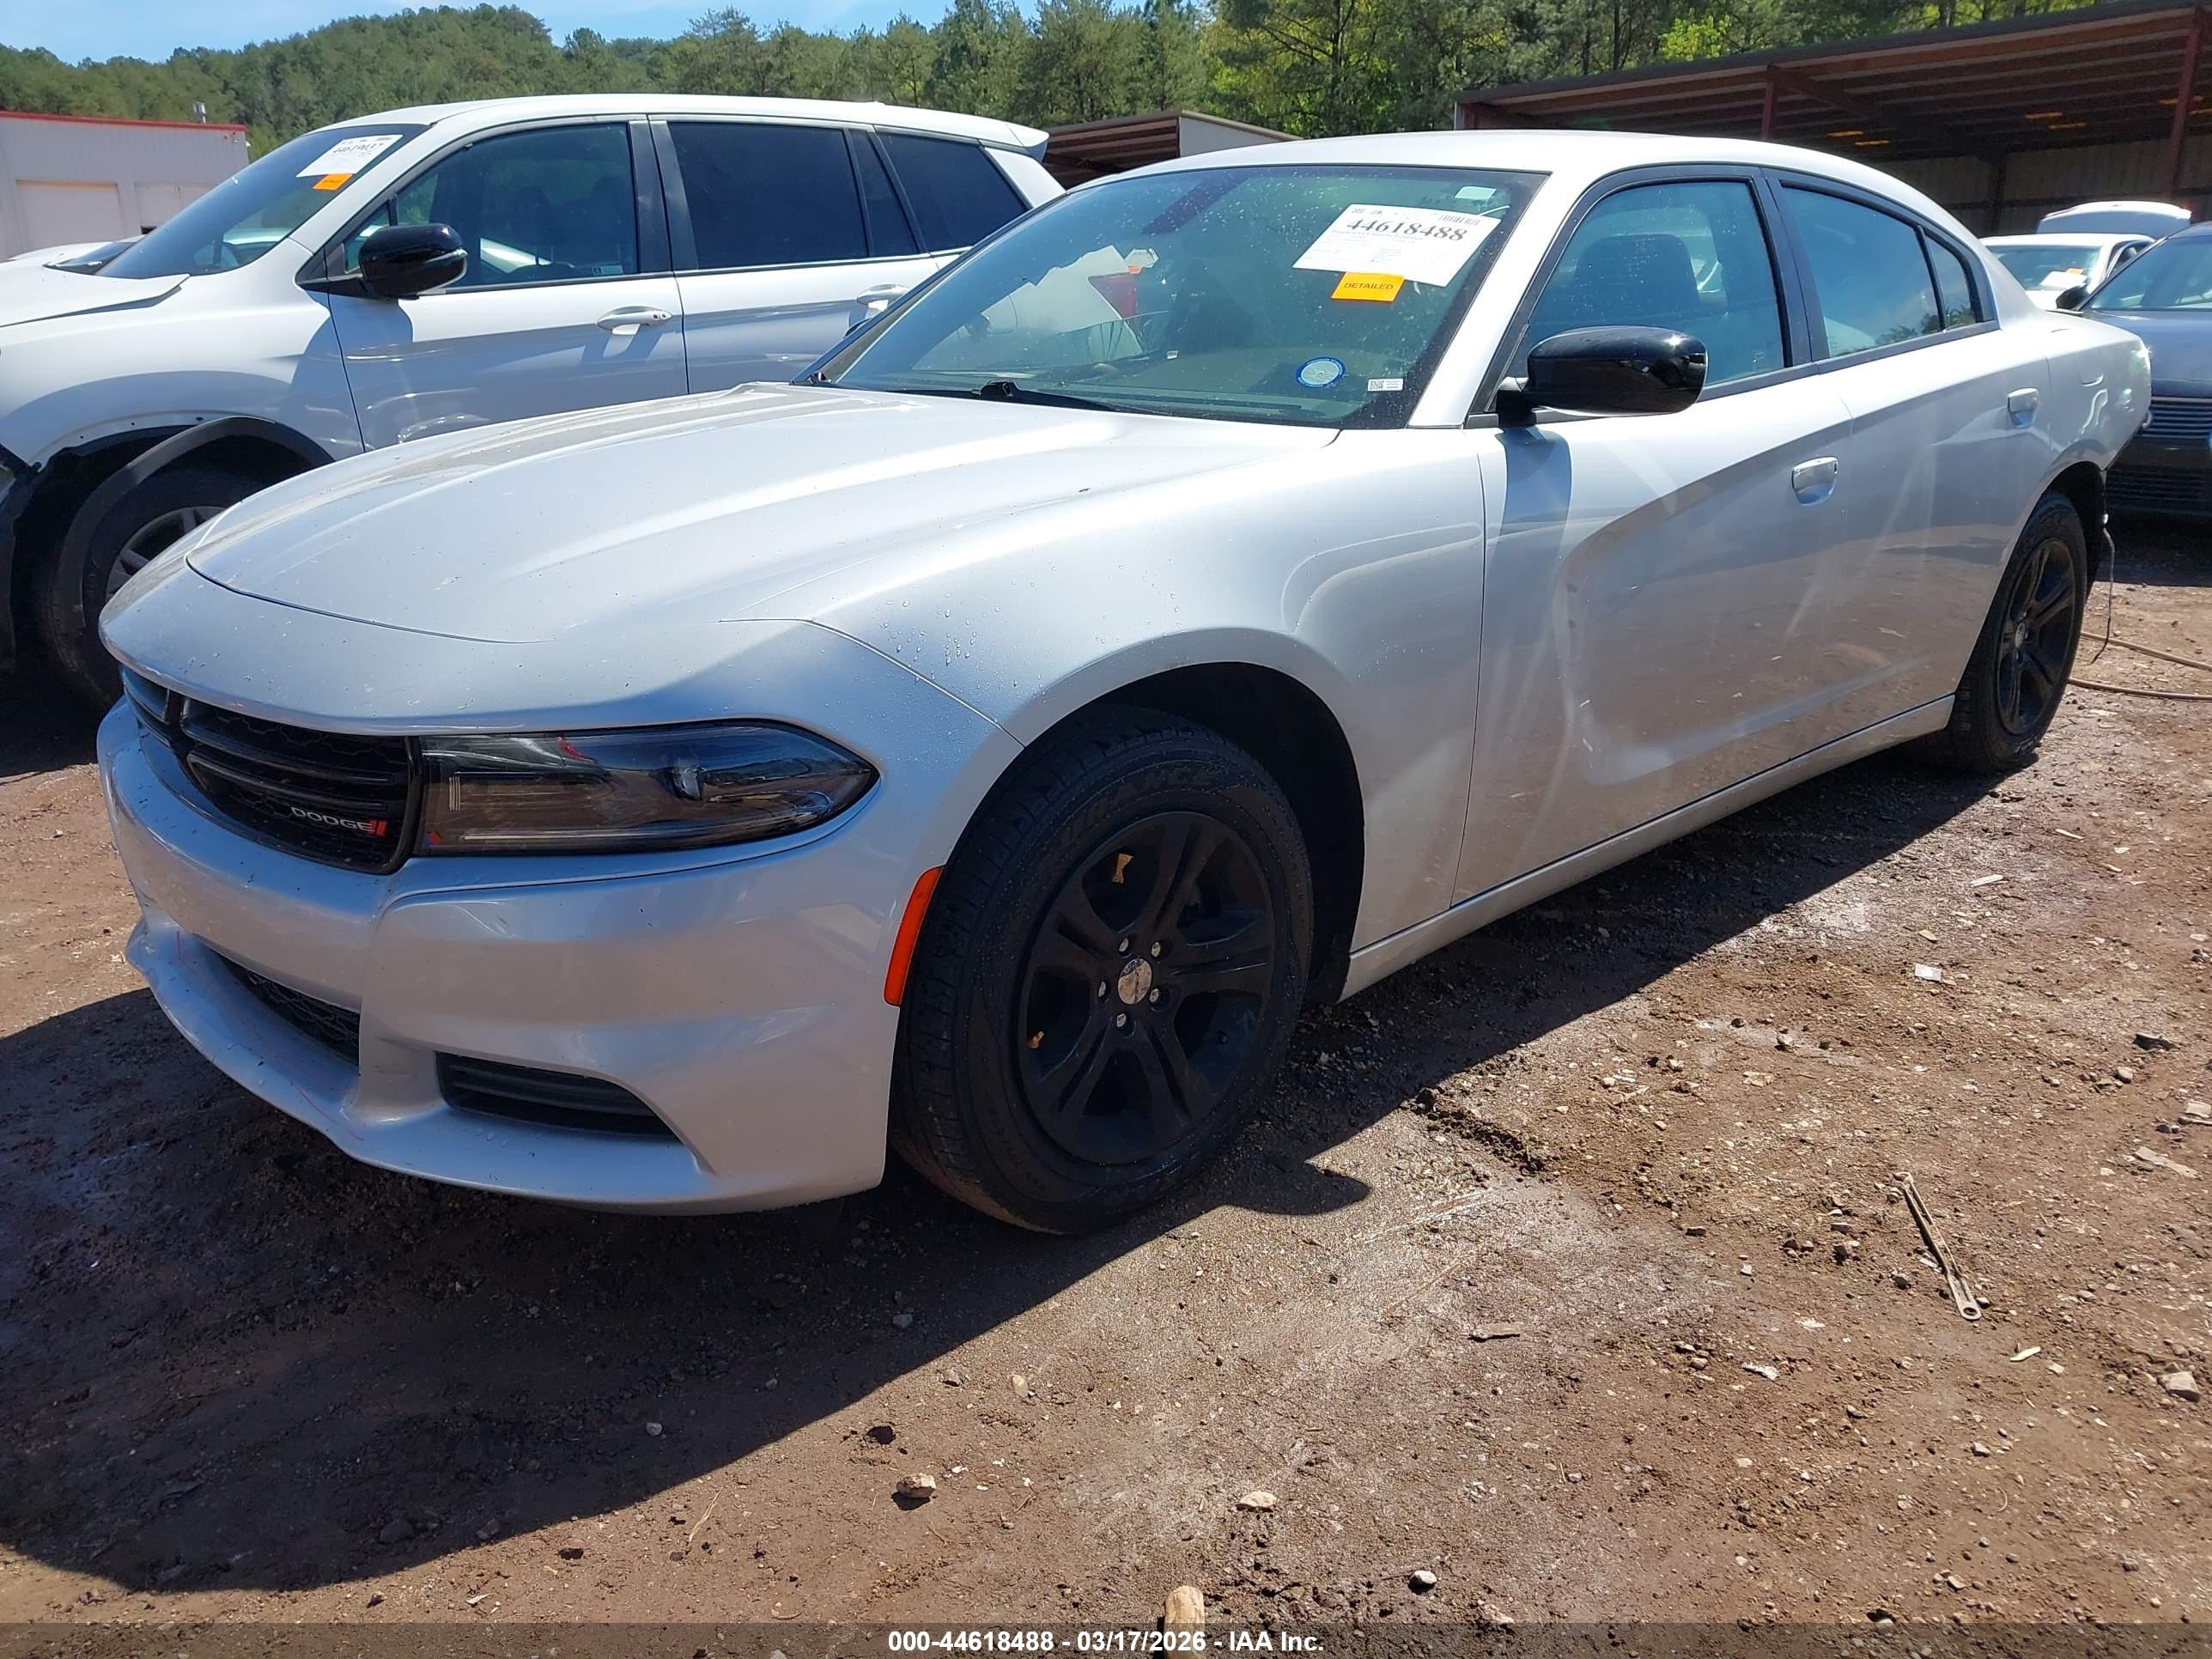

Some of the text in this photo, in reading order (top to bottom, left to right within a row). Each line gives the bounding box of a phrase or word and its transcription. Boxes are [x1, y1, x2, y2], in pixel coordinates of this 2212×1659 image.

[1346, 219, 1468, 241] 44618488
[1344, 282, 1394, 290] DETAILED
[290, 805, 375, 832] DODGE
